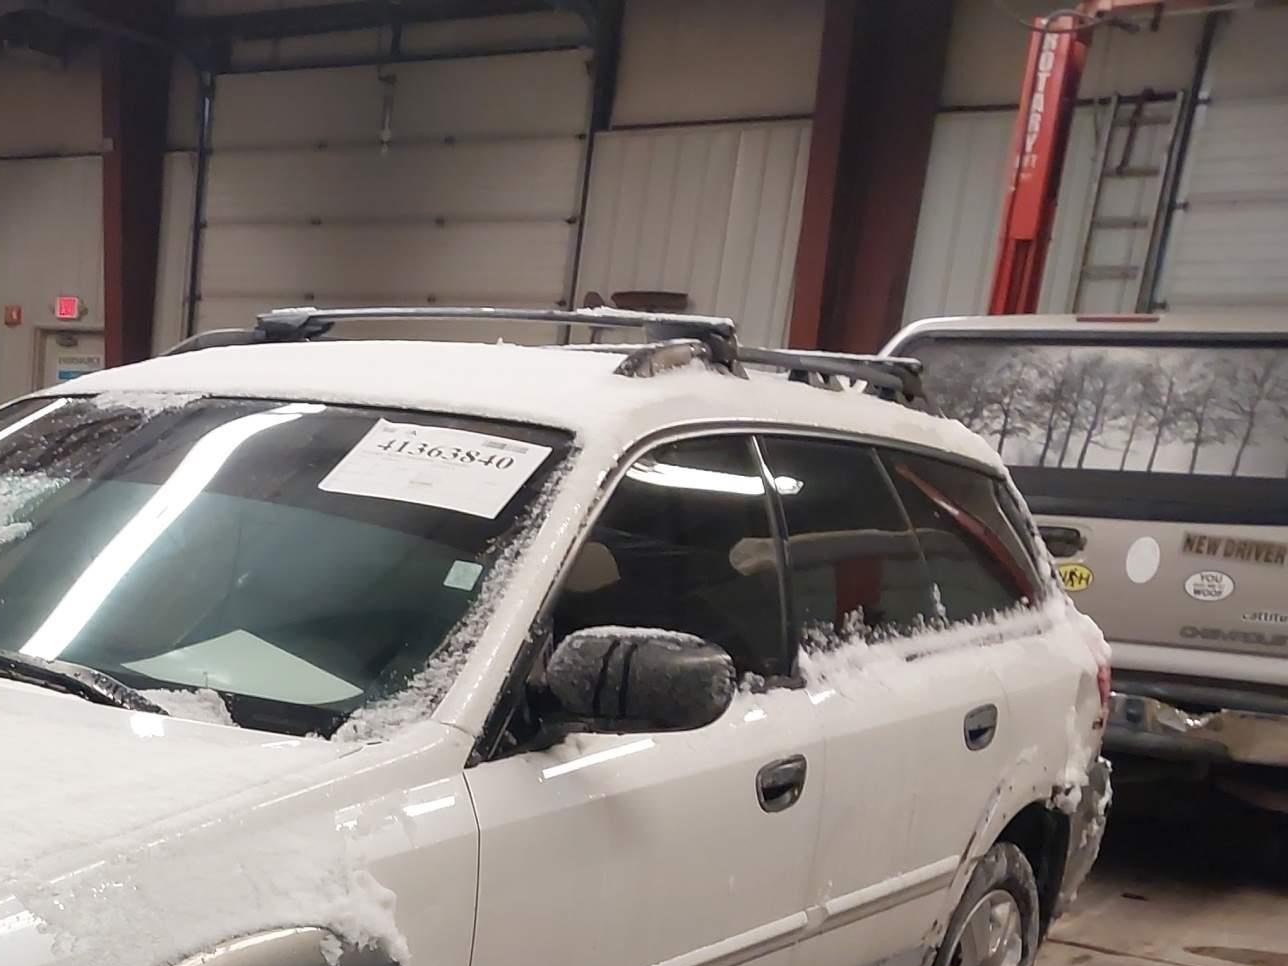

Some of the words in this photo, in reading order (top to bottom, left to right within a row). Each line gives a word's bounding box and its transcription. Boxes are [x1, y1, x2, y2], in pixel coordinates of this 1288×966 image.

[377, 439, 515, 470] 41363840
[1183, 532, 1222, 556] NEW
[1223, 537, 1286, 565] DRIVER
